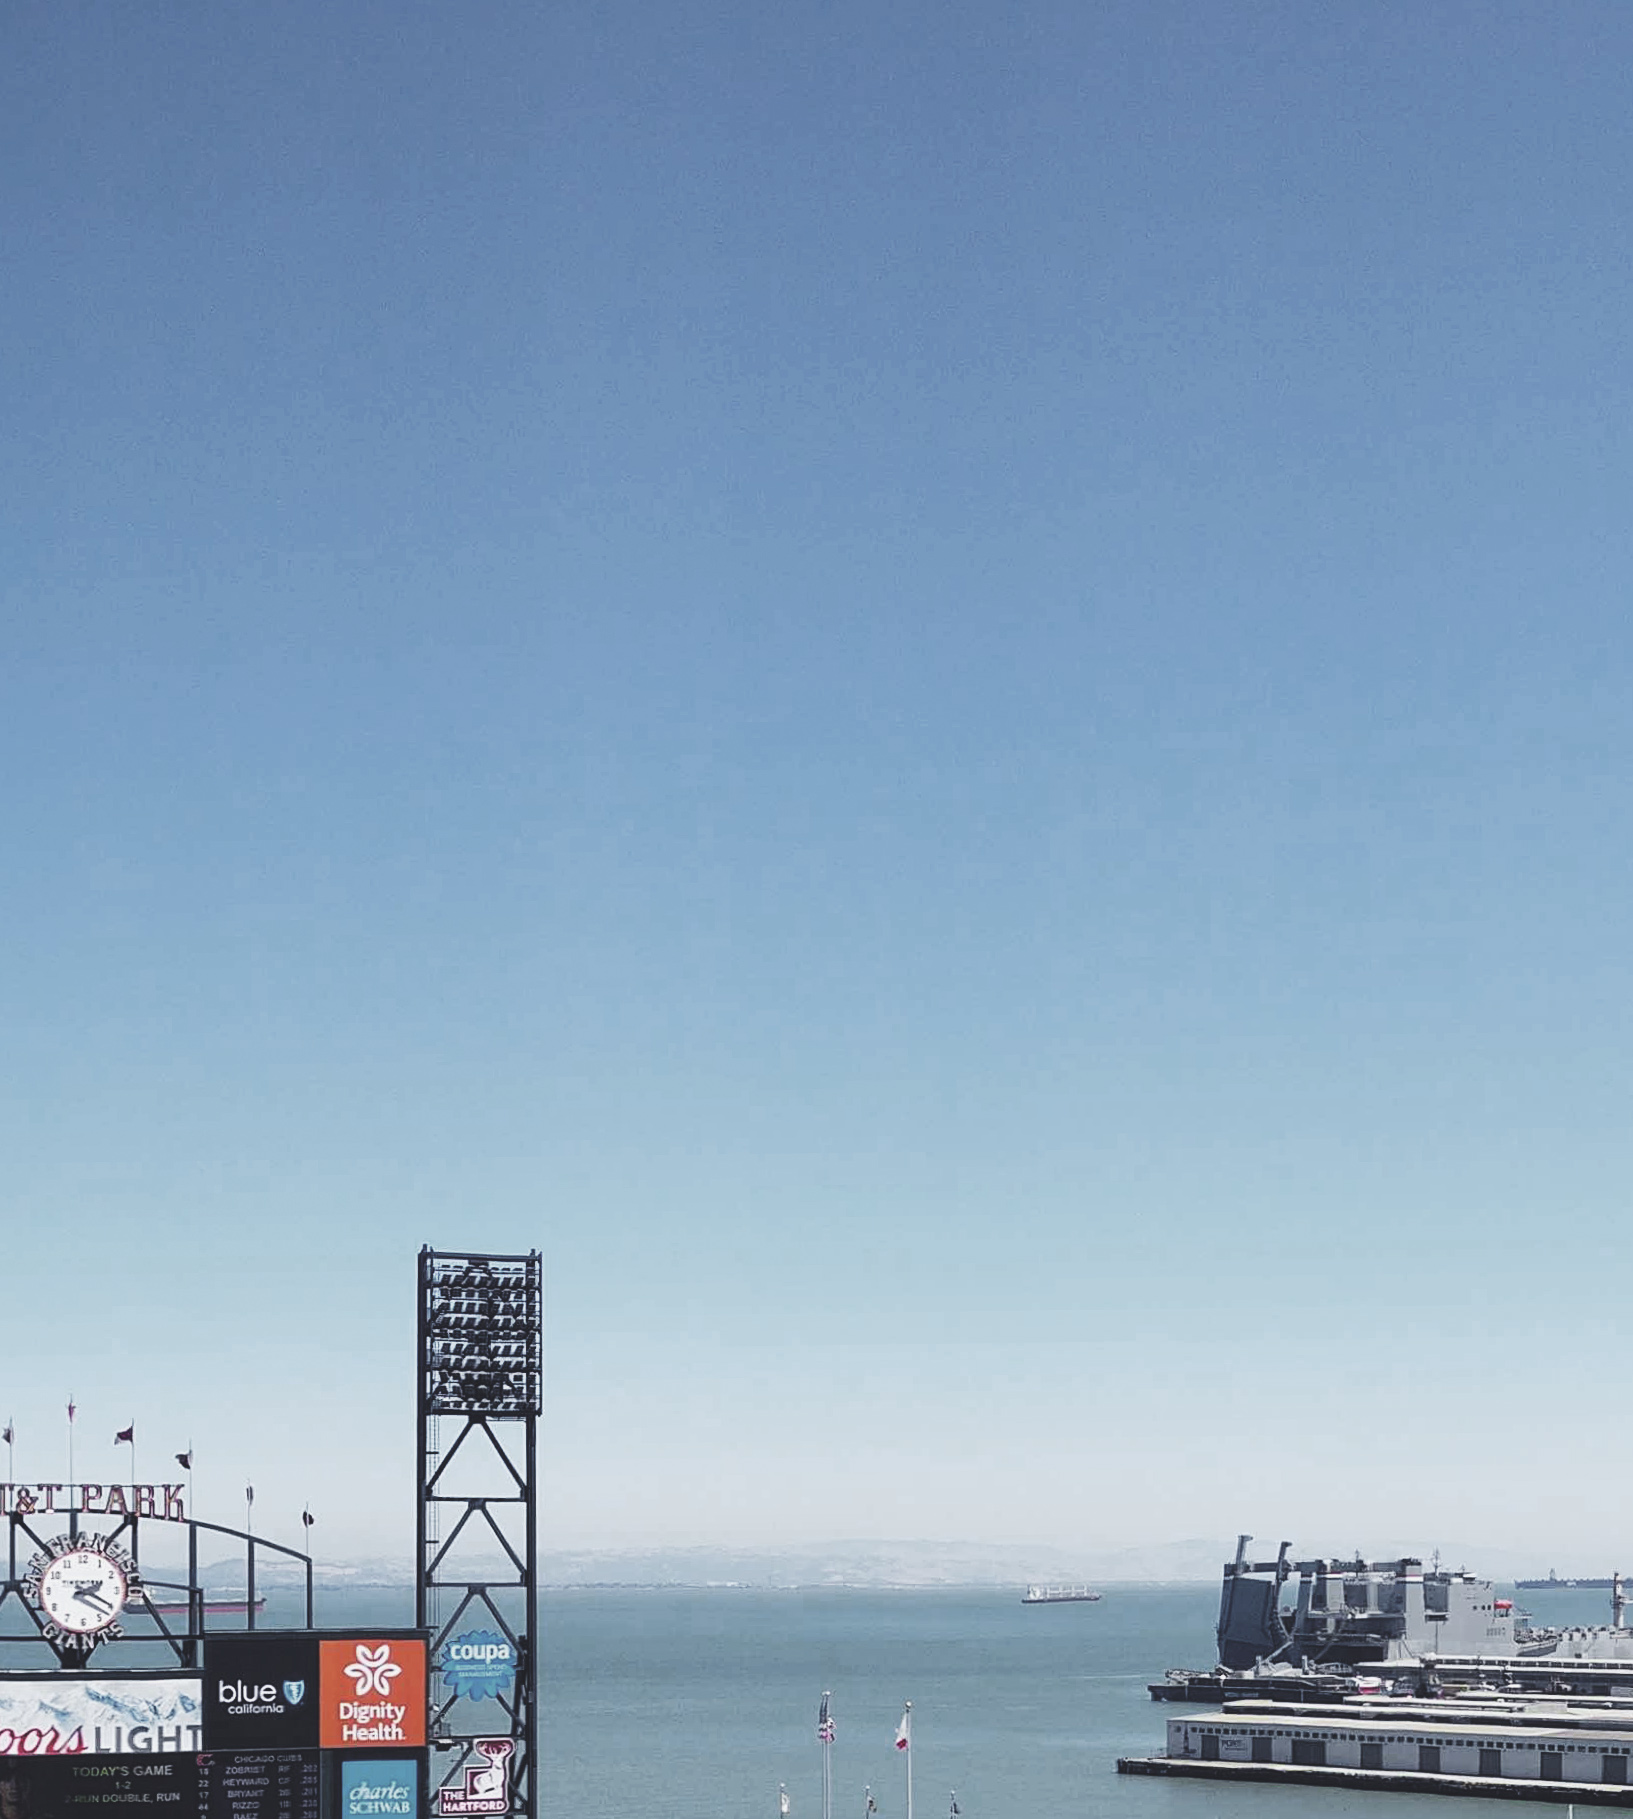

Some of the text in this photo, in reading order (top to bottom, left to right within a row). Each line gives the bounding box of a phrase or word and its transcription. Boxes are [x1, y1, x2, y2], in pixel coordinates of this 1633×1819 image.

[81, 1483, 185, 1522] PARK
[23, 1553, 50, 1598] SAN
[43, 1621, 125, 1649] GIANTS
[450, 1642, 510, 1662] coupa
[219, 1680, 277, 1703] blue
[227, 1704, 284, 1714] california
[339, 1702, 406, 1723] Dignity
[95, 1725, 202, 1754] LIGHT
[73, 1765, 174, 1777] TODAY'S GAME
[156, 1793, 181, 1801] RUN
[349, 1780, 411, 1800] charles
[443, 1790, 465, 1801] THE
[349, 1801, 411, 1815] SCHWAB
[443, 1801, 506, 1812] HARTFORD
